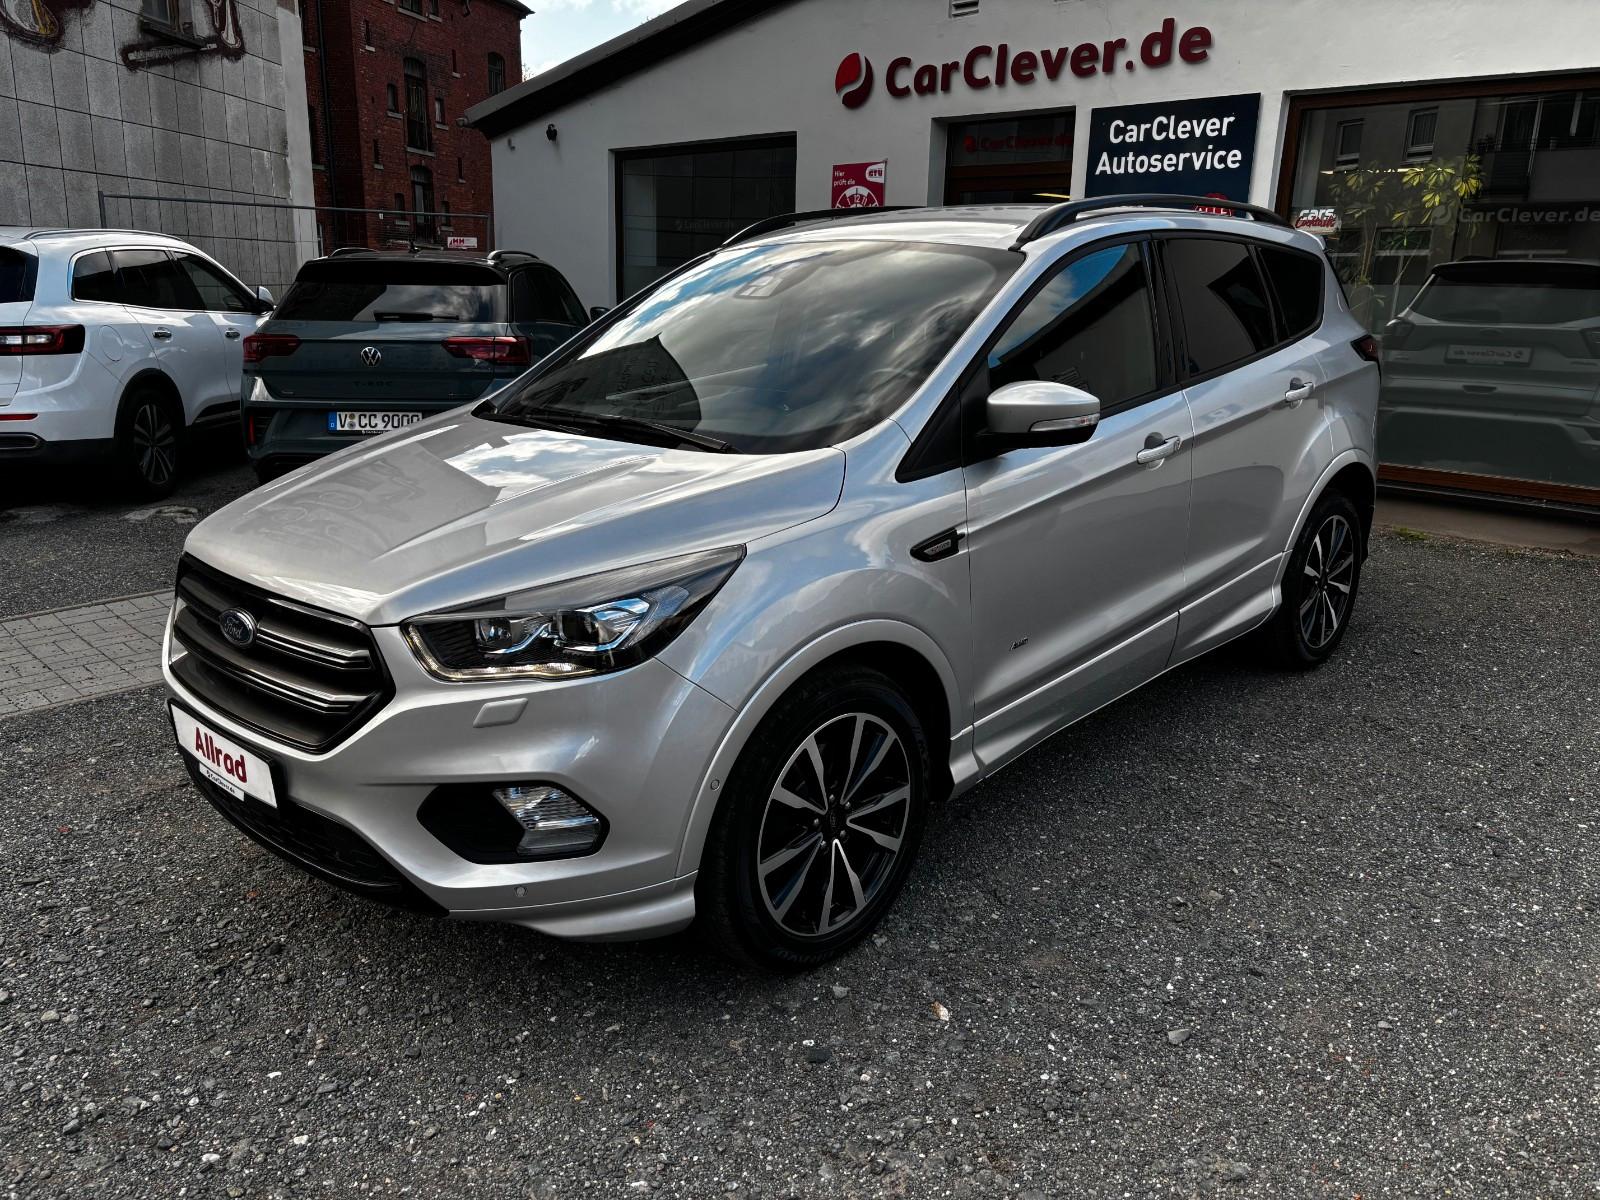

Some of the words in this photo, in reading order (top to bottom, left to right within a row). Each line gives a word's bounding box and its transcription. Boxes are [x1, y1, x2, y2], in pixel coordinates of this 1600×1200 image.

[885, 18, 1212, 98] CarClever.de
[1109, 115, 1236, 144] CarClever
[1095, 145, 1242, 175] Autoservice
[1459, 207, 1600, 223] CarClever.de
[338, 413, 348, 429] V
[358, 413, 378, 429] CC
[195, 726, 248, 784] Allrad
